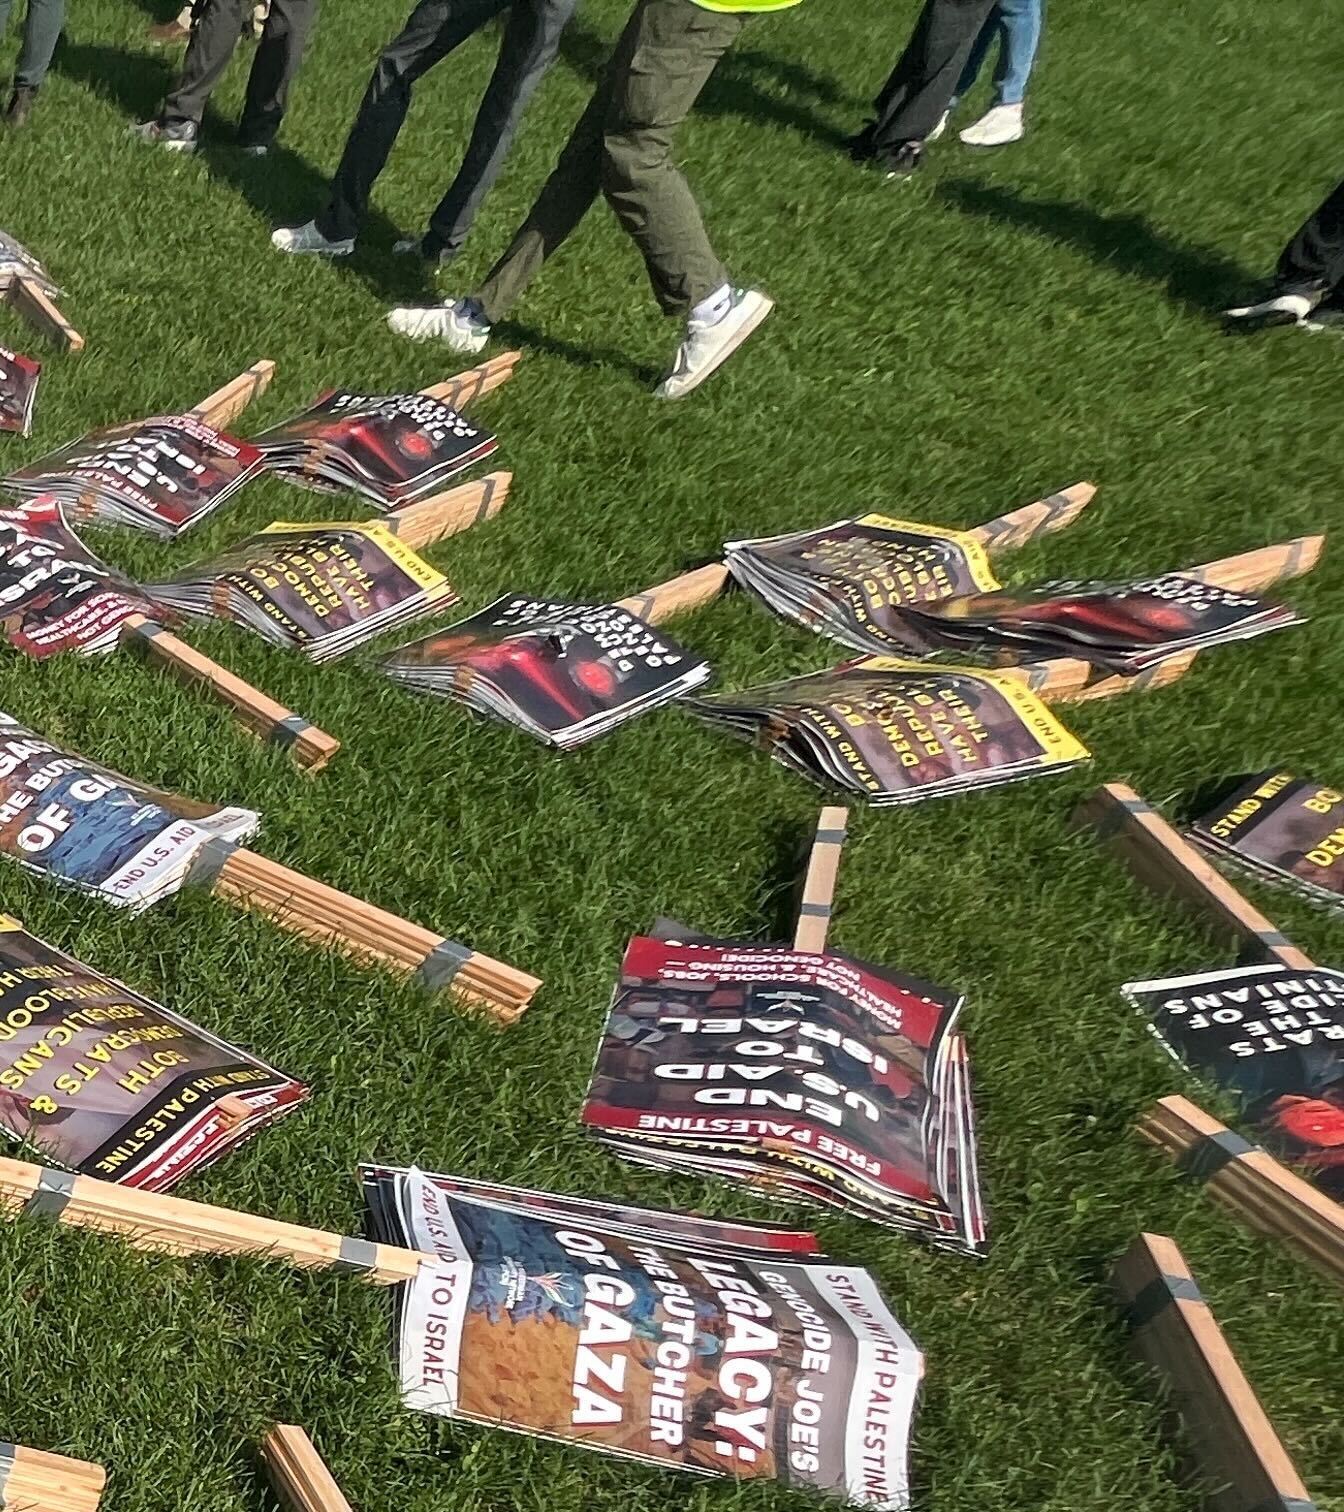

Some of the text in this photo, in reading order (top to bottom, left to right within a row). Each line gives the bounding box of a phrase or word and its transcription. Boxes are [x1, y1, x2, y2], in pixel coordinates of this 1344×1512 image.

[7, 545, 57, 568] TO
[16, 804, 72, 852] OF
[170, 826, 195, 850] AID
[1188, 1008, 1244, 1030] OF
[1242, 1010, 1332, 1036] THE
[658, 1016, 888, 1075] ISRAEL
[734, 1040, 825, 1066] TO
[653, 1063, 880, 1123] U.S. AID
[694, 1087, 844, 1127] END
[96, 1084, 199, 1176] PALESTINE
[637, 1114, 814, 1143] PALESTINE
[554, 1230, 637, 1428] OF GAZA
[629, 1246, 698, 1448] THE BUTCHER
[687, 1255, 781, 1463] LEGACY:
[758, 1270, 833, 1474] GENOCIDE JOE'S
